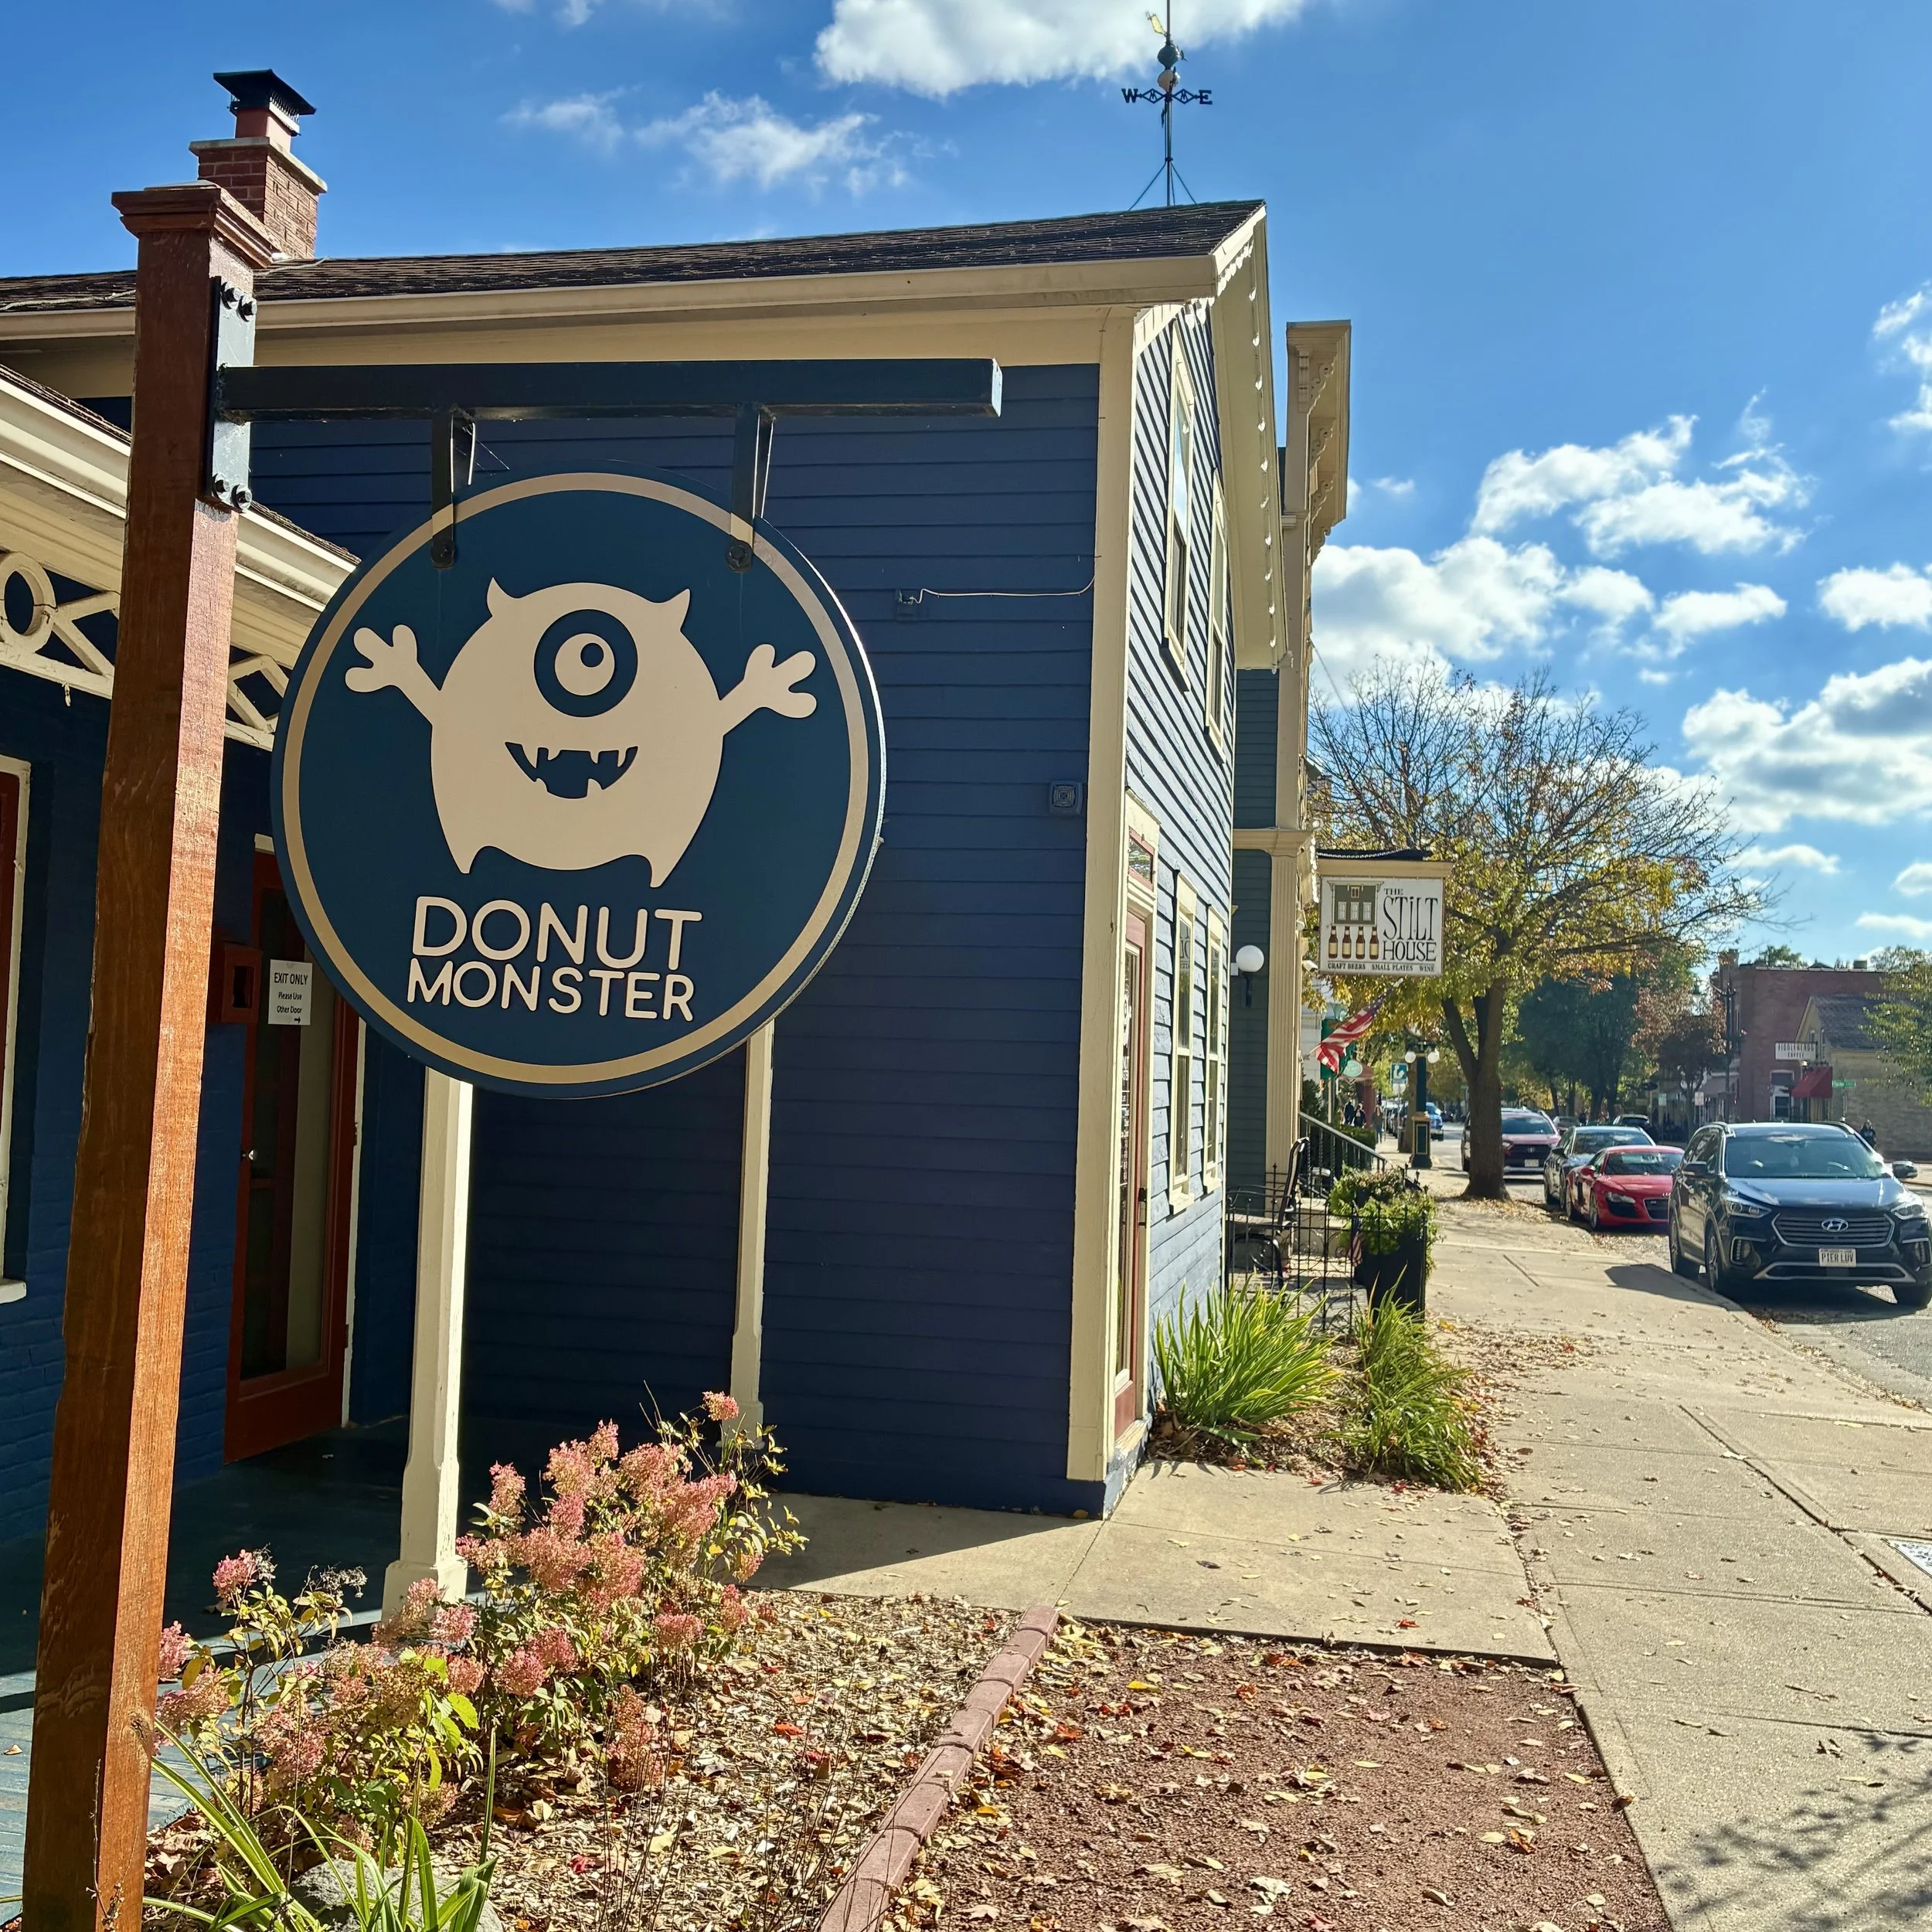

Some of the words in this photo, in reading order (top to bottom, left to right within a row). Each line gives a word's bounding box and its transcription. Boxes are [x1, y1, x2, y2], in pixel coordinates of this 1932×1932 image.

[1121, 88, 1138, 104] W
[1199, 90, 1213, 105] E
[413, 896, 702, 971] DONUT
[1383, 940, 1437, 961] HOUSE
[274, 972, 288, 983] EXIT
[290, 974, 308, 985] ONLY
[293, 992, 302, 1000] Use
[406, 958, 695, 1022] MONSTER
[1821, 1252, 1838, 1263] PIER
[1840, 1252, 1854, 1264] LUV
